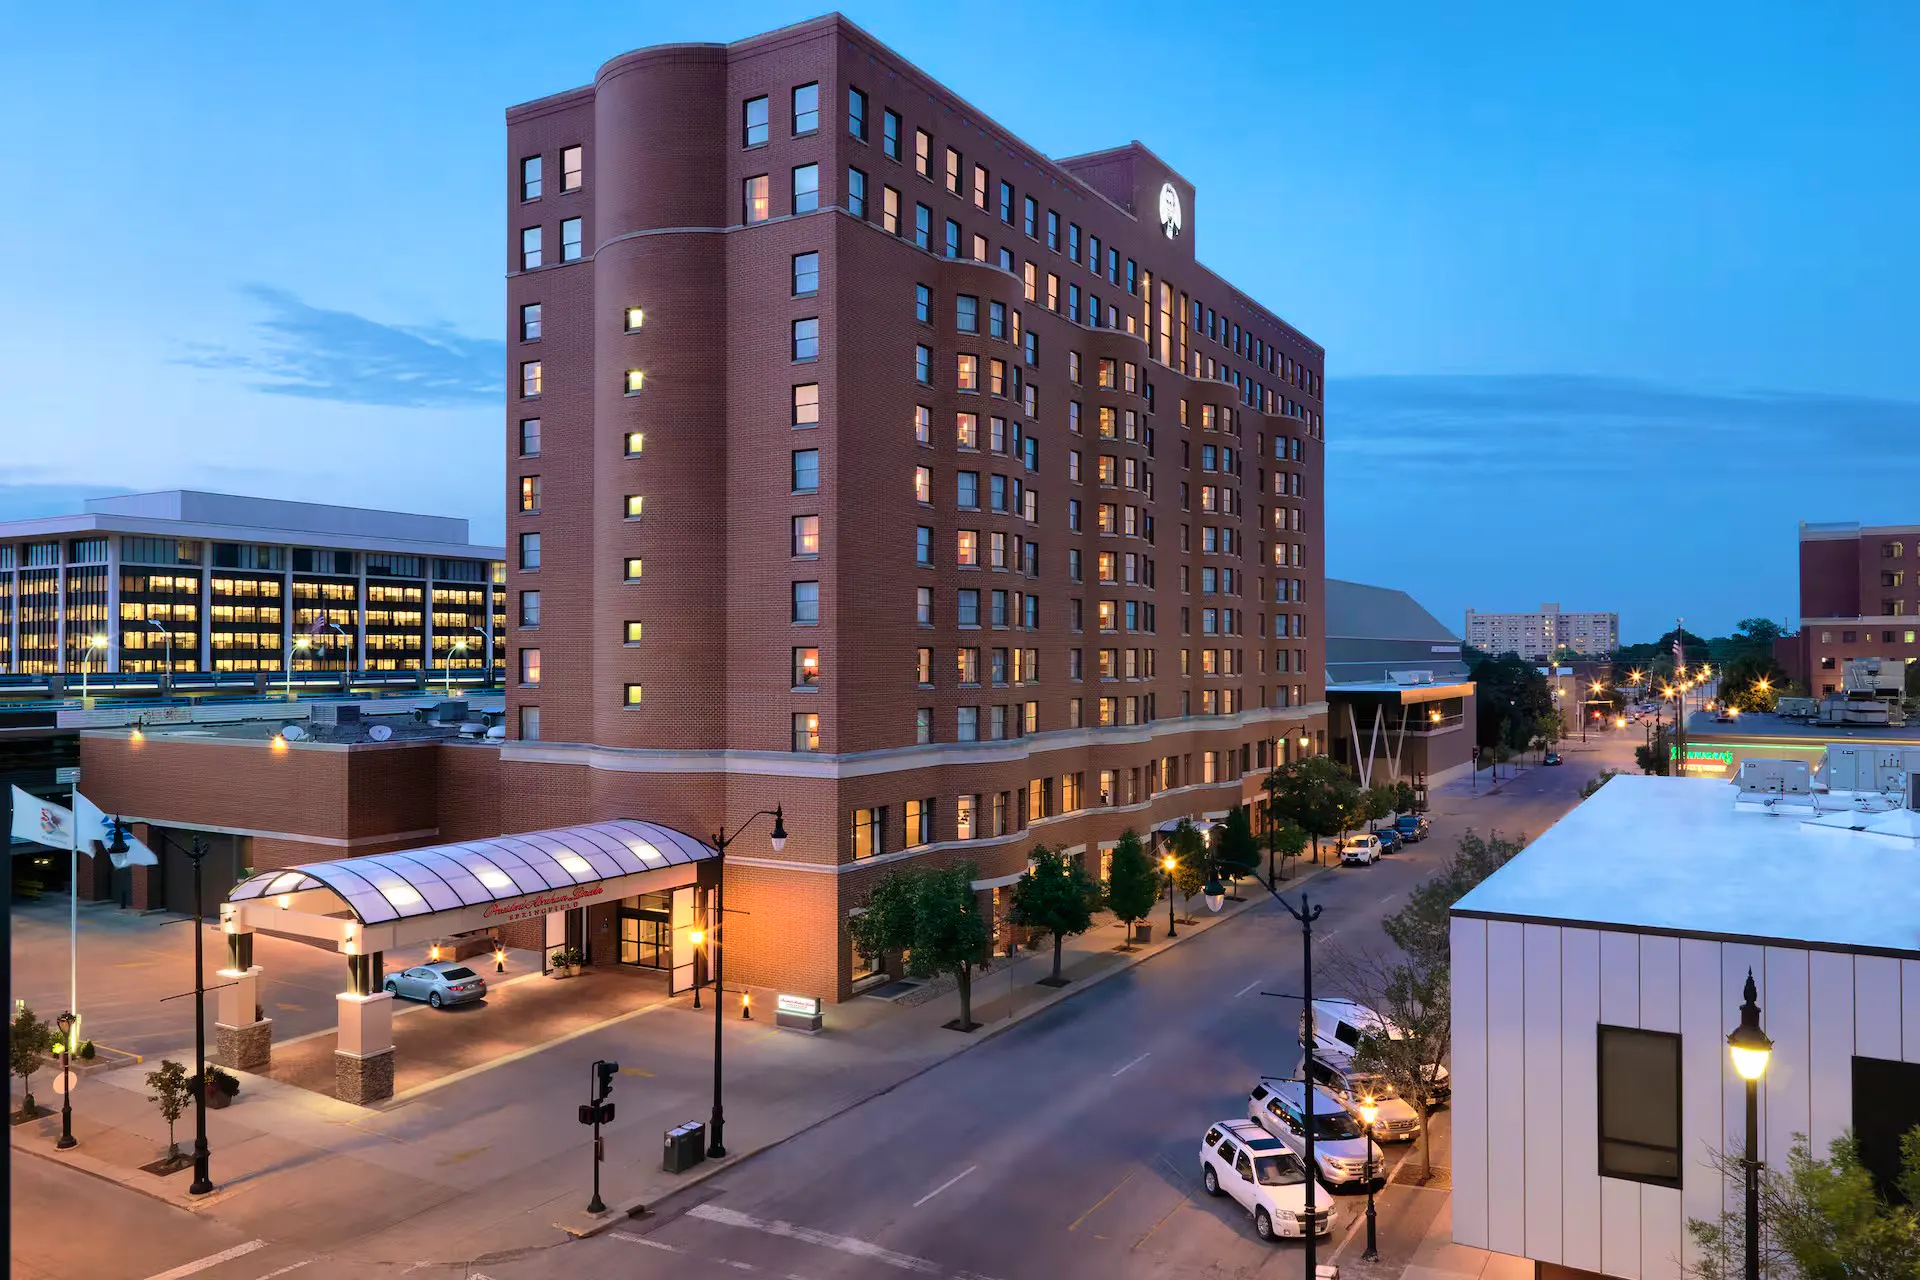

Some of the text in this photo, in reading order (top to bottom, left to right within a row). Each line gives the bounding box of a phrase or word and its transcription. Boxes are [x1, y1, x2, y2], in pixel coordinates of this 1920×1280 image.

[483, 884, 604, 918] President Abraham Lincoln
[509, 901, 579, 920] SPRINGFIELD
